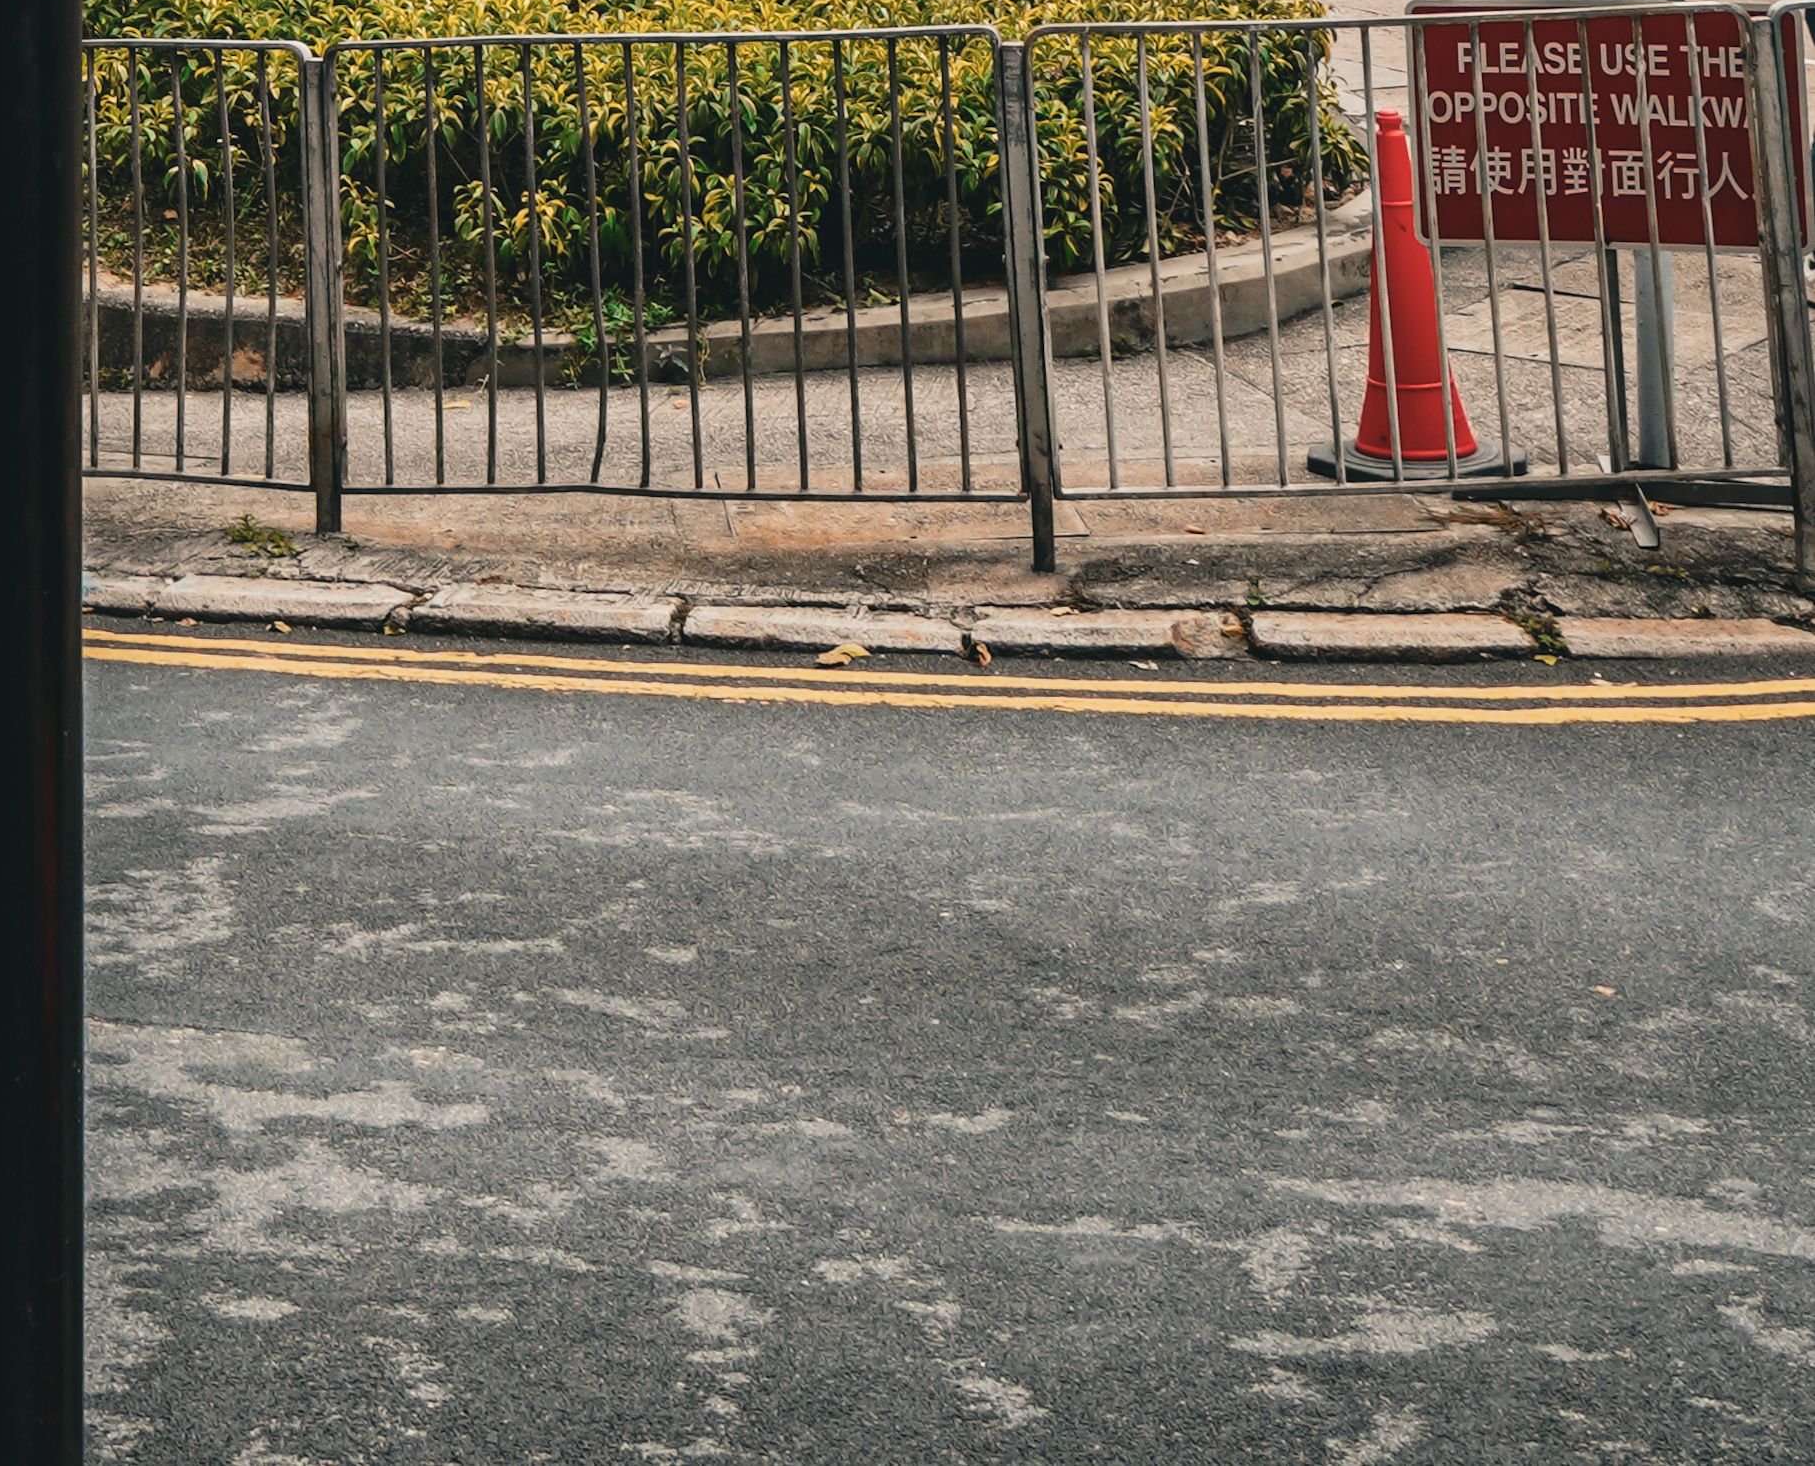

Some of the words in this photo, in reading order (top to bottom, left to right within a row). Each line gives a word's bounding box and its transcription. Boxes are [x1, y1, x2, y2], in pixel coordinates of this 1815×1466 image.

[1457, 41, 1583, 75] PLEASE
[1599, 43, 1670, 77] USE
[1679, 44, 1744, 79] THE
[1428, 90, 1601, 124] OPPOSITE
[1610, 93, 1749, 129] WALKW
[1431, 144, 1756, 201] 請使用對面行人
